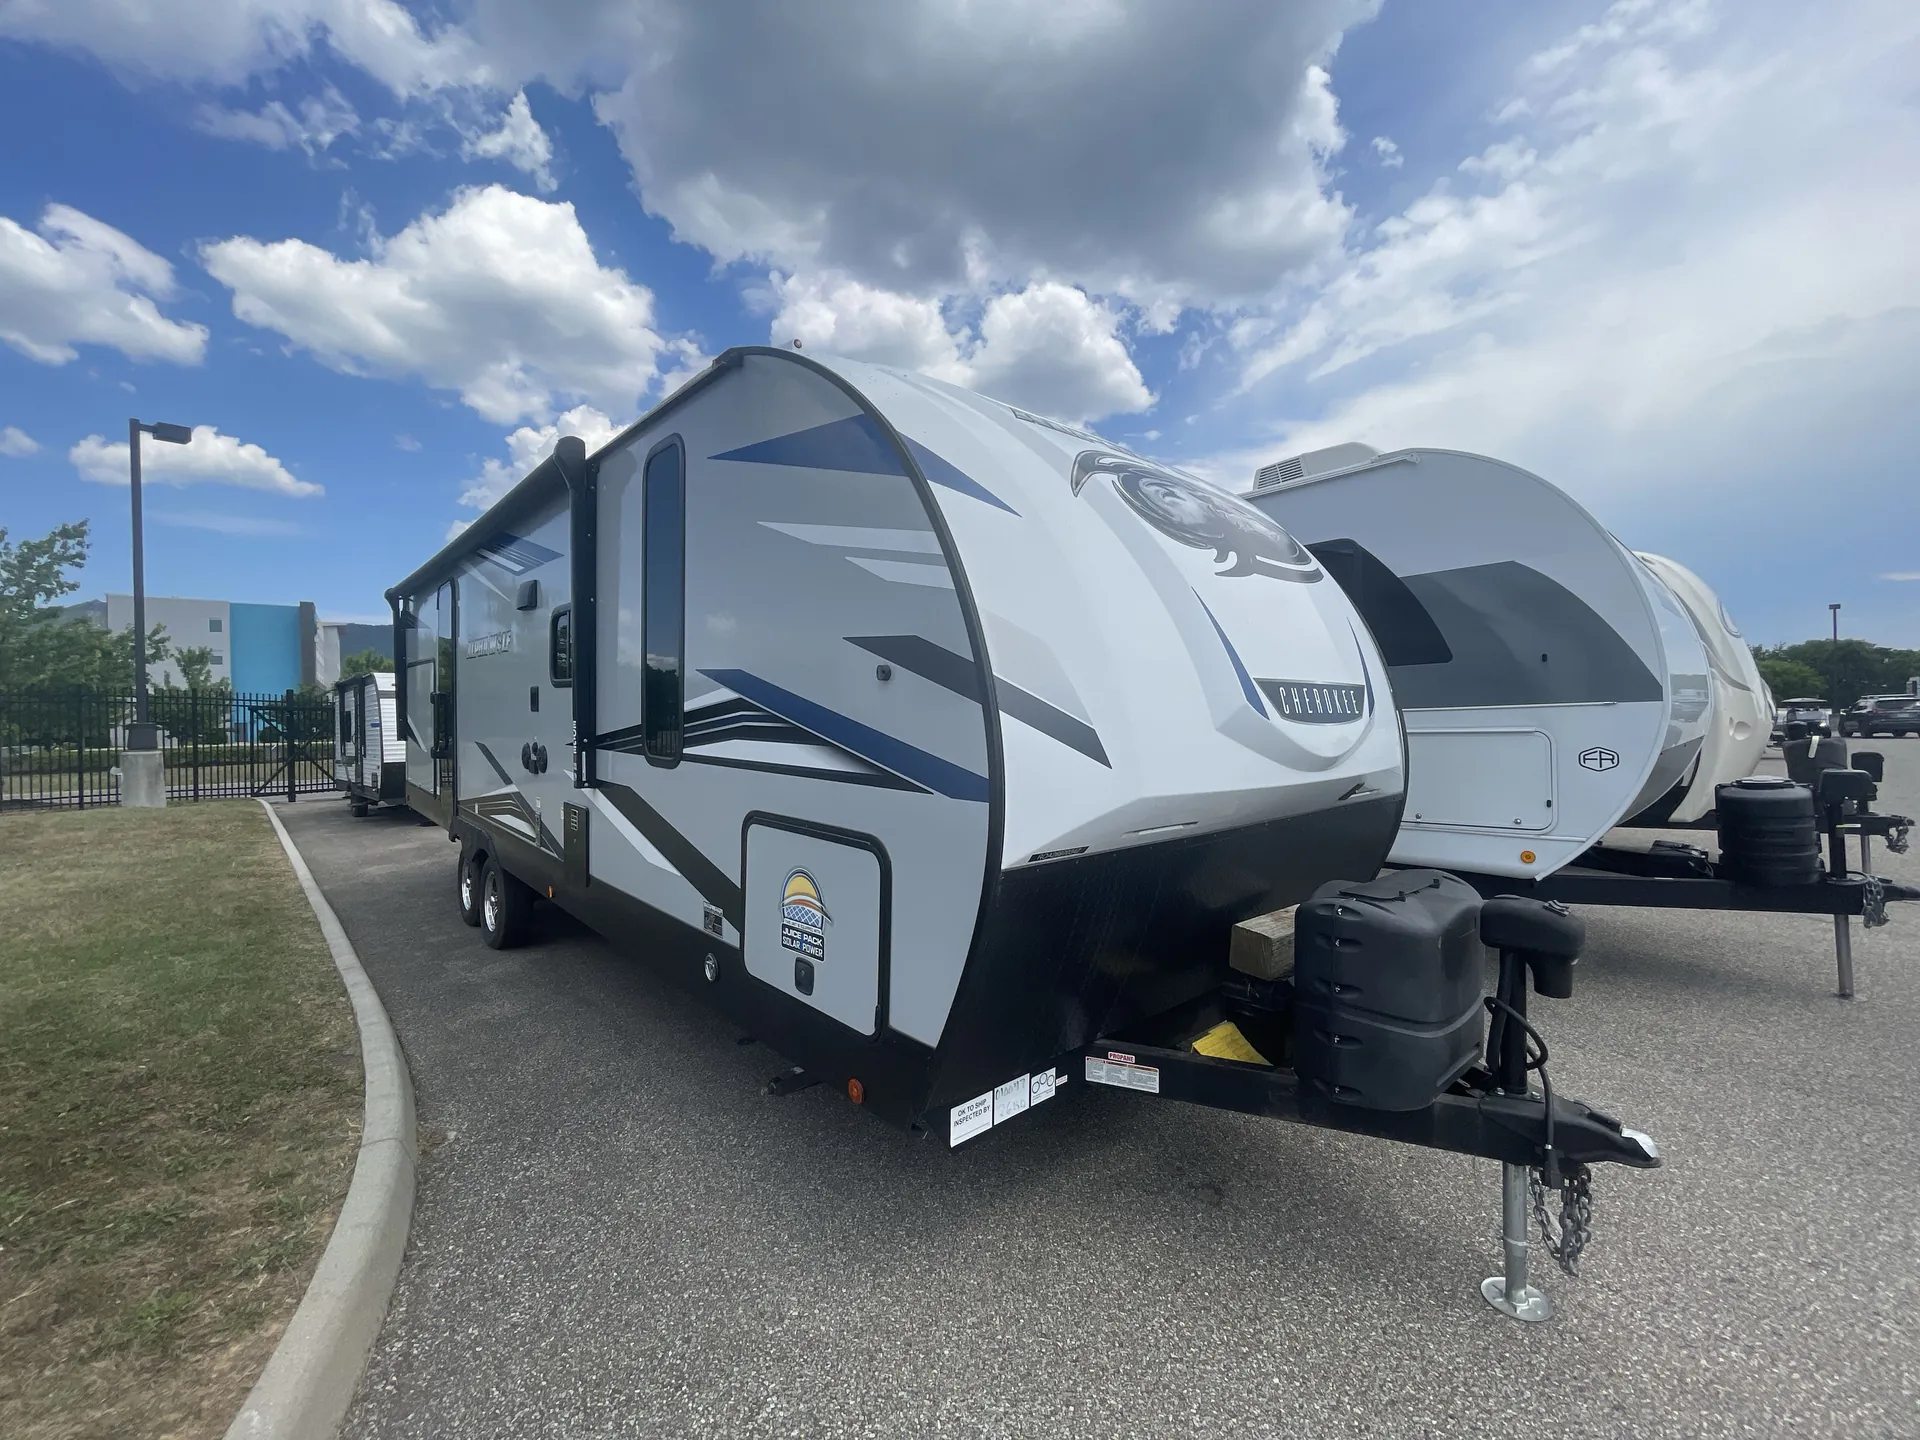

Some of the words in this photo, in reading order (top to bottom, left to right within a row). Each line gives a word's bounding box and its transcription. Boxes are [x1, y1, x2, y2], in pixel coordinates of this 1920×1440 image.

[1279, 686, 1360, 714] CHEROKEE
[782, 927, 802, 940] JUICE
[803, 933, 823, 947] PACK
[782, 935, 801, 950] SOLAR
[802, 942, 823, 958] POWER
[1109, 1052, 1134, 1063] PROPANE
[953, 1109, 983, 1128] INSPECTED
[983, 1104, 991, 1114] BY
[957, 1108, 967, 1117] OK
[967, 1104, 975, 1113] TO
[975, 1098, 987, 1109] SHIP
